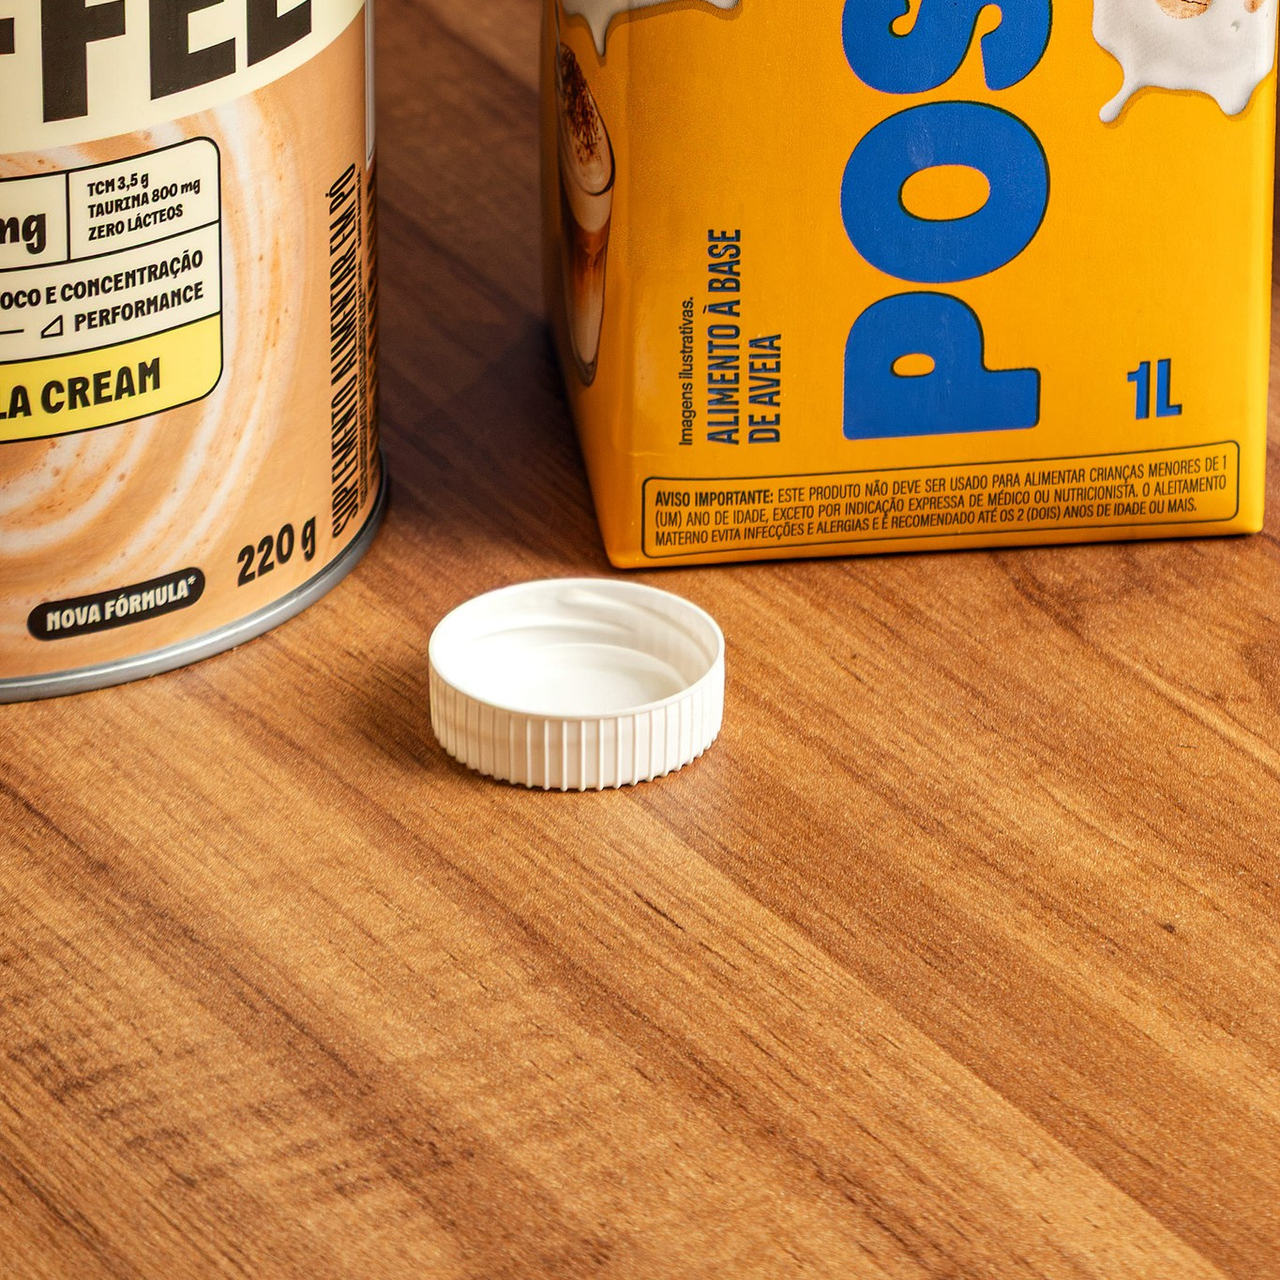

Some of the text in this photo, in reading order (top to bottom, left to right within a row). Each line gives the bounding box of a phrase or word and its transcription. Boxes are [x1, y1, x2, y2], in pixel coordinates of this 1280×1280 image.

[87, 172, 149, 197] TCM 3,5 g
[87, 178, 201, 219] TAURINA 800 mg
[88, 203, 183, 241] ZERO LÁCTEOS
[45, 286, 57, 305] E
[60, 249, 204, 302] CONCENTRAÇÃO
[74, 281, 204, 332] PERFORMANCE
[325, 163, 358, 538] SUPLEMENTO ALIMENTAR EM PÓ
[702, 229, 741, 446] ALIMENTO À BASE
[41, 356, 161, 415] CREAM
[678, 296, 696, 446] Imagens ilustrativas.
[747, 333, 782, 444] DE AVEIA
[1127, 358, 1183, 421] 1L
[655, 455, 1227, 507] AVISO IMPORTANTE: ESTE PRODUTO NÃO DEVE SER USADO PARA ALIMENTAR CRIANÇAS MENORES DE 1
[655, 475, 1226, 529] (UM) ANO DE IDADE, EXCETO POR INDICAÇÃO EXPRESSA DE MÉDICO OU NUTRICIONISTA. O ALEITAMENTO
[655, 530, 708, 546] MATERNO
[711, 528, 741, 543] EVITA
[744, 521, 804, 540] INFECÇÕES
[807, 522, 814, 535] E
[816, 519, 869, 534] ALERGIAS
[872, 517, 879, 530] E
[891, 511, 974, 529] RECOMENDADO
[977, 508, 997, 524] ATÉ
[1000, 508, 1014, 522] OS
[1017, 508, 1024, 521] 2
[1027, 505, 1060, 522] (DOIS)
[1063, 504, 1094, 519] ANOS
[1096, 503, 1110, 517] DE
[1113, 501, 1146, 516] IDADE
[1149, 500, 1165, 514] OU
[1168, 497, 1197, 512] MAIS.
[237, 515, 316, 587] 220 g
[46, 602, 101, 632] NOVA
